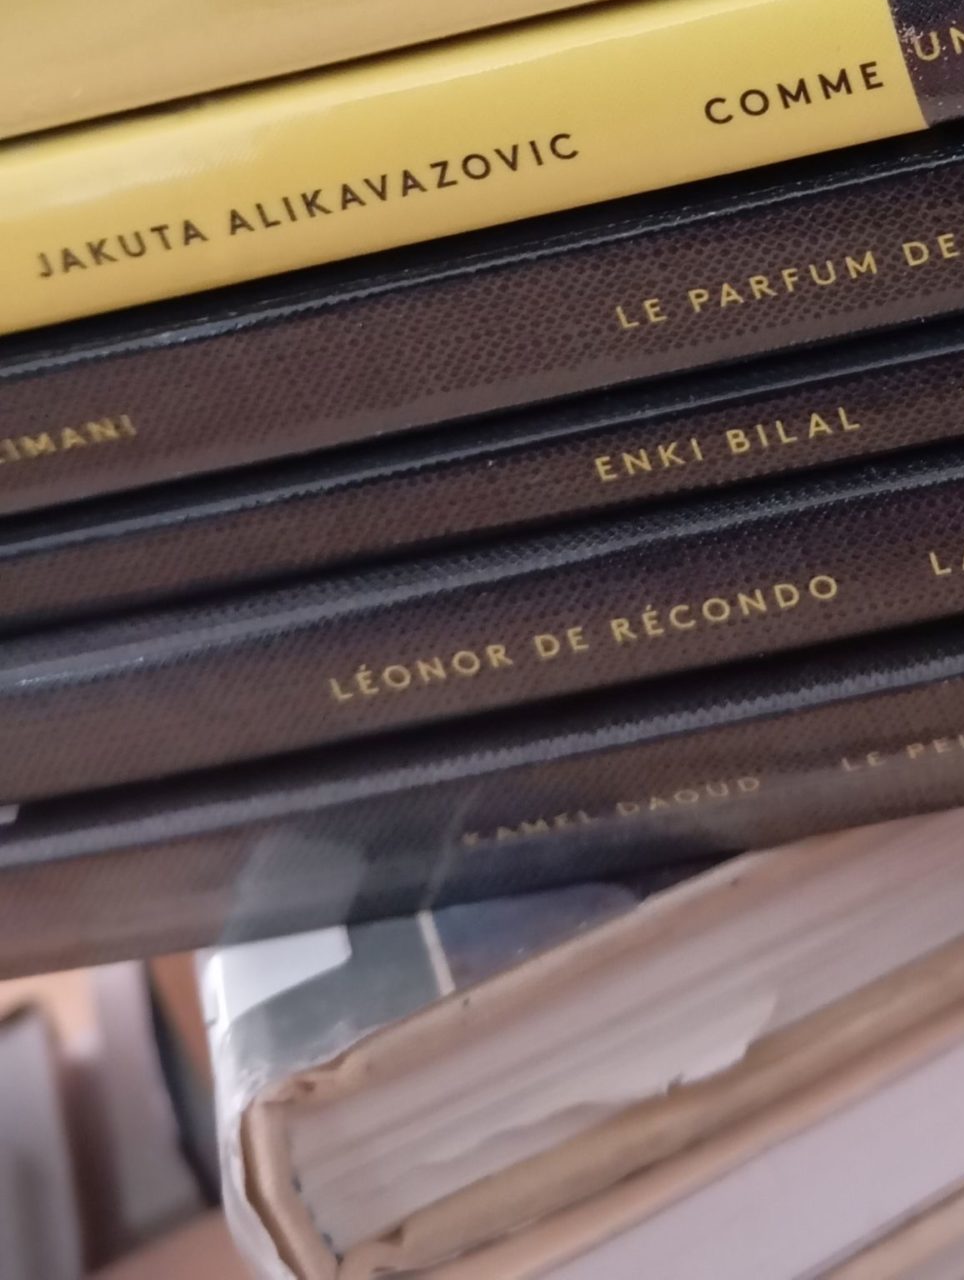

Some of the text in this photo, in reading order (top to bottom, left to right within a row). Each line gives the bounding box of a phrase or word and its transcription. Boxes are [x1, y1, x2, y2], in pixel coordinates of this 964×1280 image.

[703, 61, 884, 126] COMME
[37, 132, 581, 279] JAKUTA ALIKAVAZOVIC
[616, 298, 668, 329] LE
[688, 250, 879, 313] PARFUM
[596, 407, 861, 482] ENKI BILAL
[331, 574, 839, 702] LÉONOR DE RÉCONDO
[615, 775, 761, 818] DAOUD
[841, 750, 887, 773] LE
